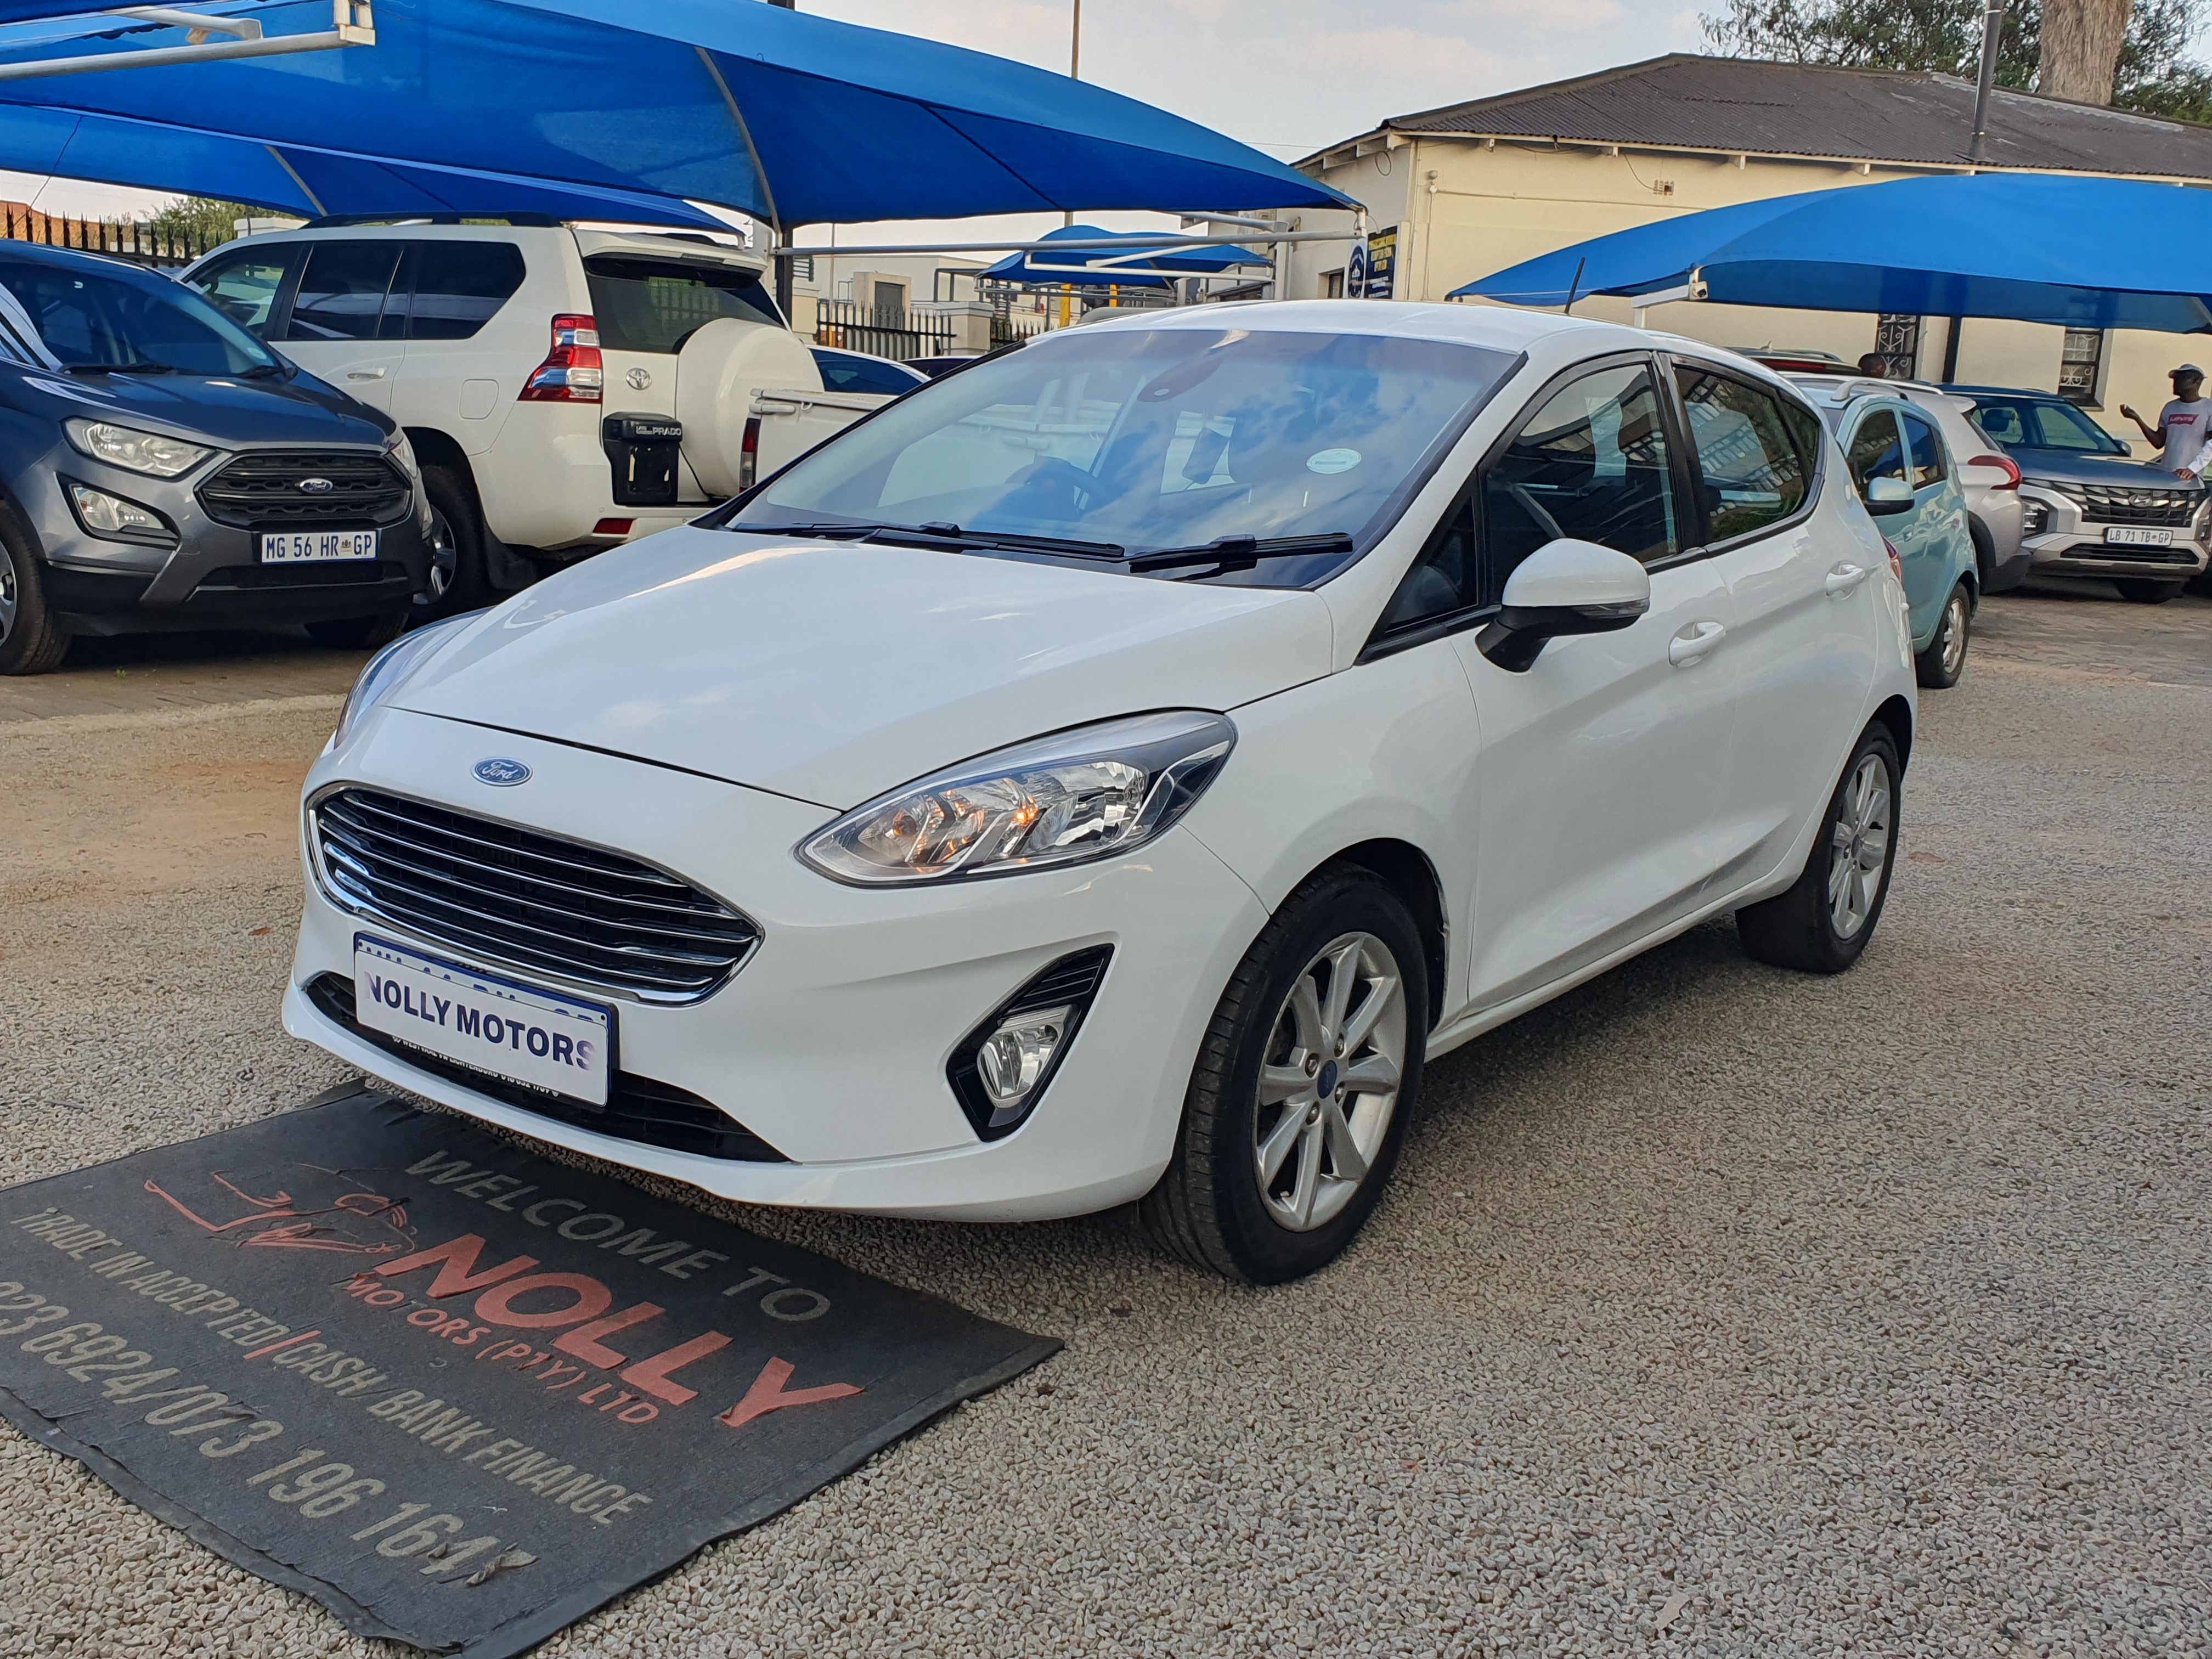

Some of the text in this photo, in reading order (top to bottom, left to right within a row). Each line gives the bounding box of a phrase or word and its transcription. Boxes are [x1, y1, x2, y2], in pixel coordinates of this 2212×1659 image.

[652, 426, 681, 436] PRADO
[266, 534, 373, 559] MG 56 HR GP
[2109, 529, 2169, 543] LB 71 TB GP
[482, 761, 519, 780] Ford
[364, 970, 597, 1071] NOLLY MOTORS
[405, 1150, 831, 1321] WELCOME TO
[10, 1207, 123, 1260] TRADE
[89, 1251, 155, 1278] IN
[365, 1389, 496, 1454] BANK
[461, 1437, 654, 1525] FINANCE
[342, 1273, 492, 1345] MOORS
[577, 1382, 659, 1423] LTD
[374, 1233, 866, 1427] NOLLY
[245, 1447, 386, 1519] 196
